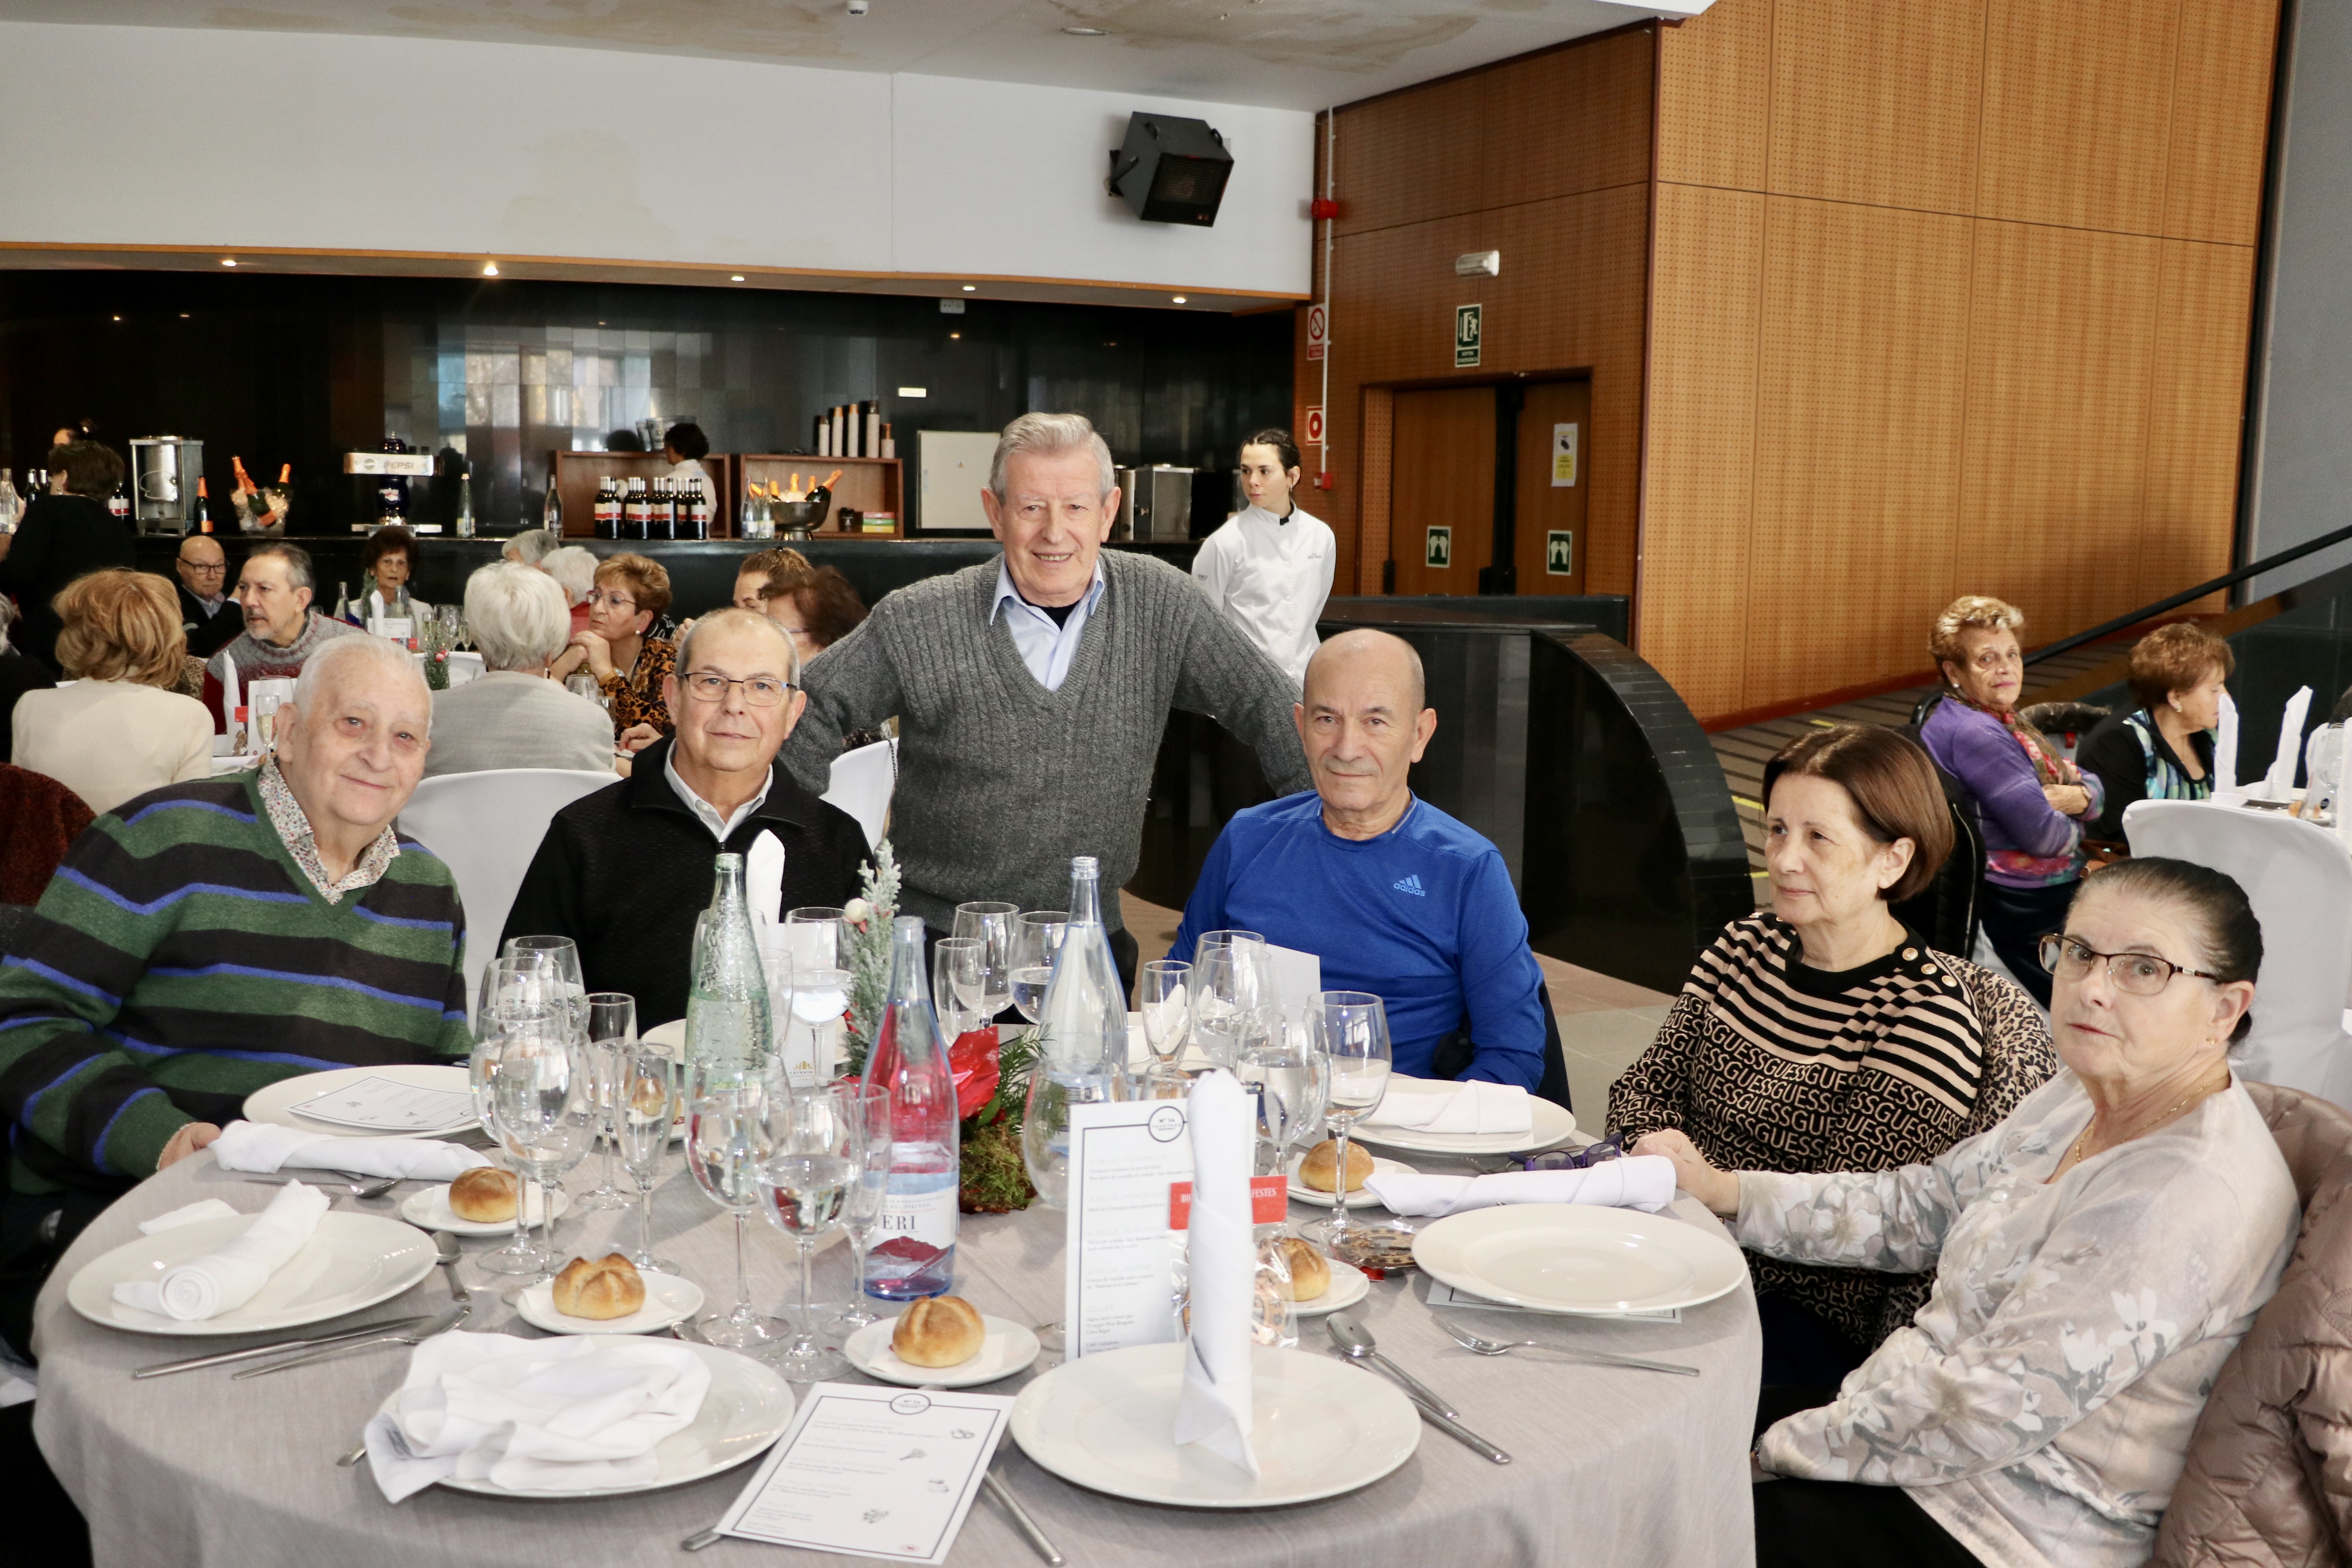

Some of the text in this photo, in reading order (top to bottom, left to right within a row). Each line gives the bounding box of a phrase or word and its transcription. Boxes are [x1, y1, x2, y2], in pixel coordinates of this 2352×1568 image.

[383, 461, 414, 470] PEPSI
[1393, 882, 1426, 897] adidas
[1252, 1188, 1277, 1198] FESTES
